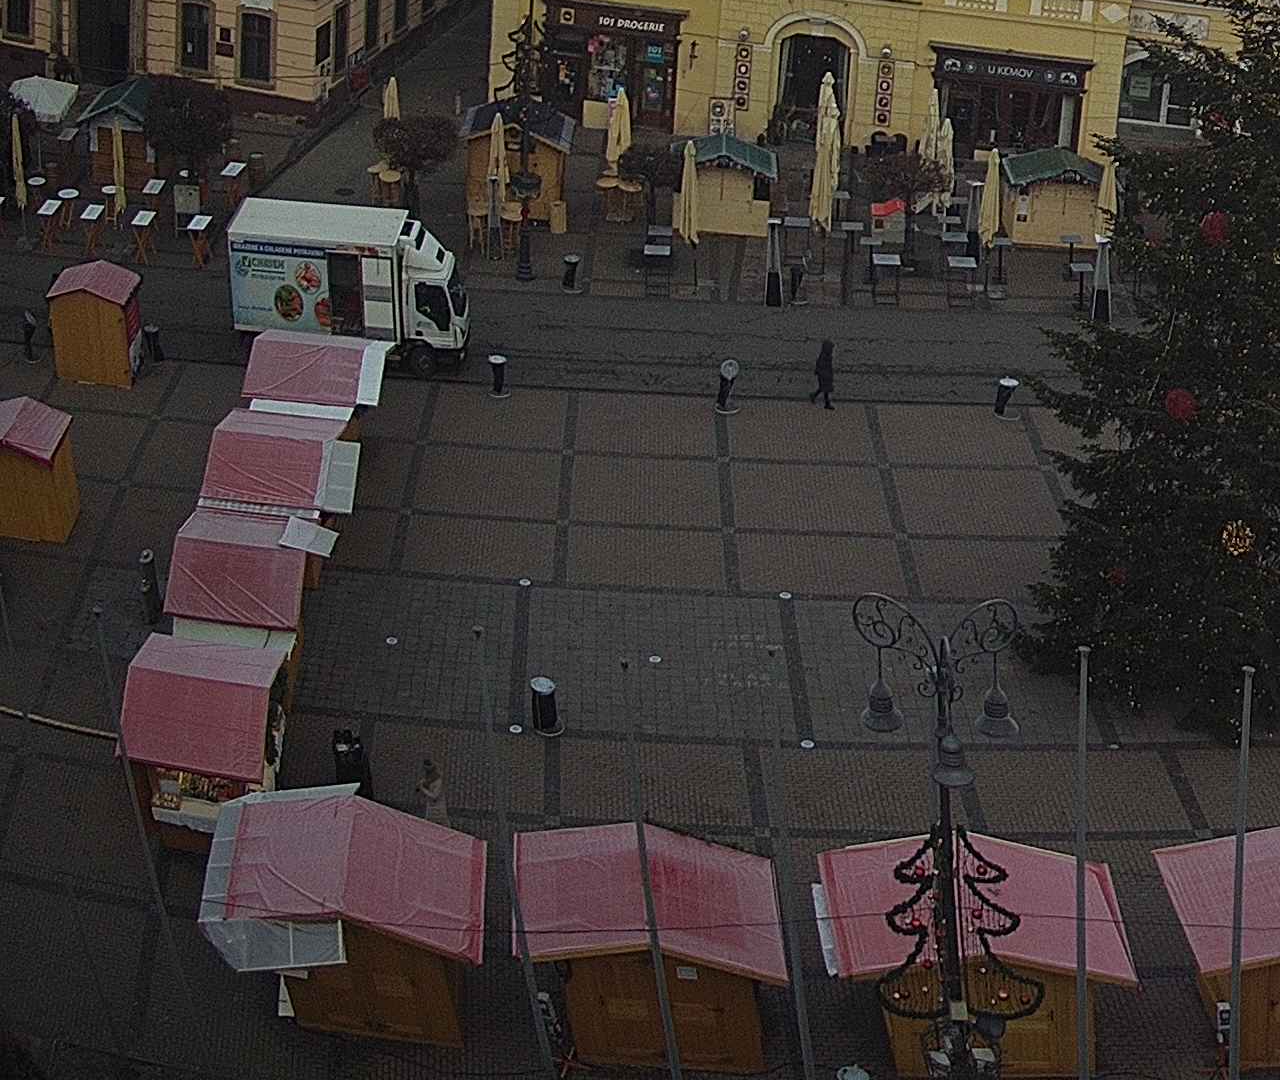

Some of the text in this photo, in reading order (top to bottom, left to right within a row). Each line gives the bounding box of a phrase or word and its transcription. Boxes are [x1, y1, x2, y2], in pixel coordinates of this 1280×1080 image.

[599, 16, 665, 32] 101 DROGERIE
[987, 64, 996, 74] U
